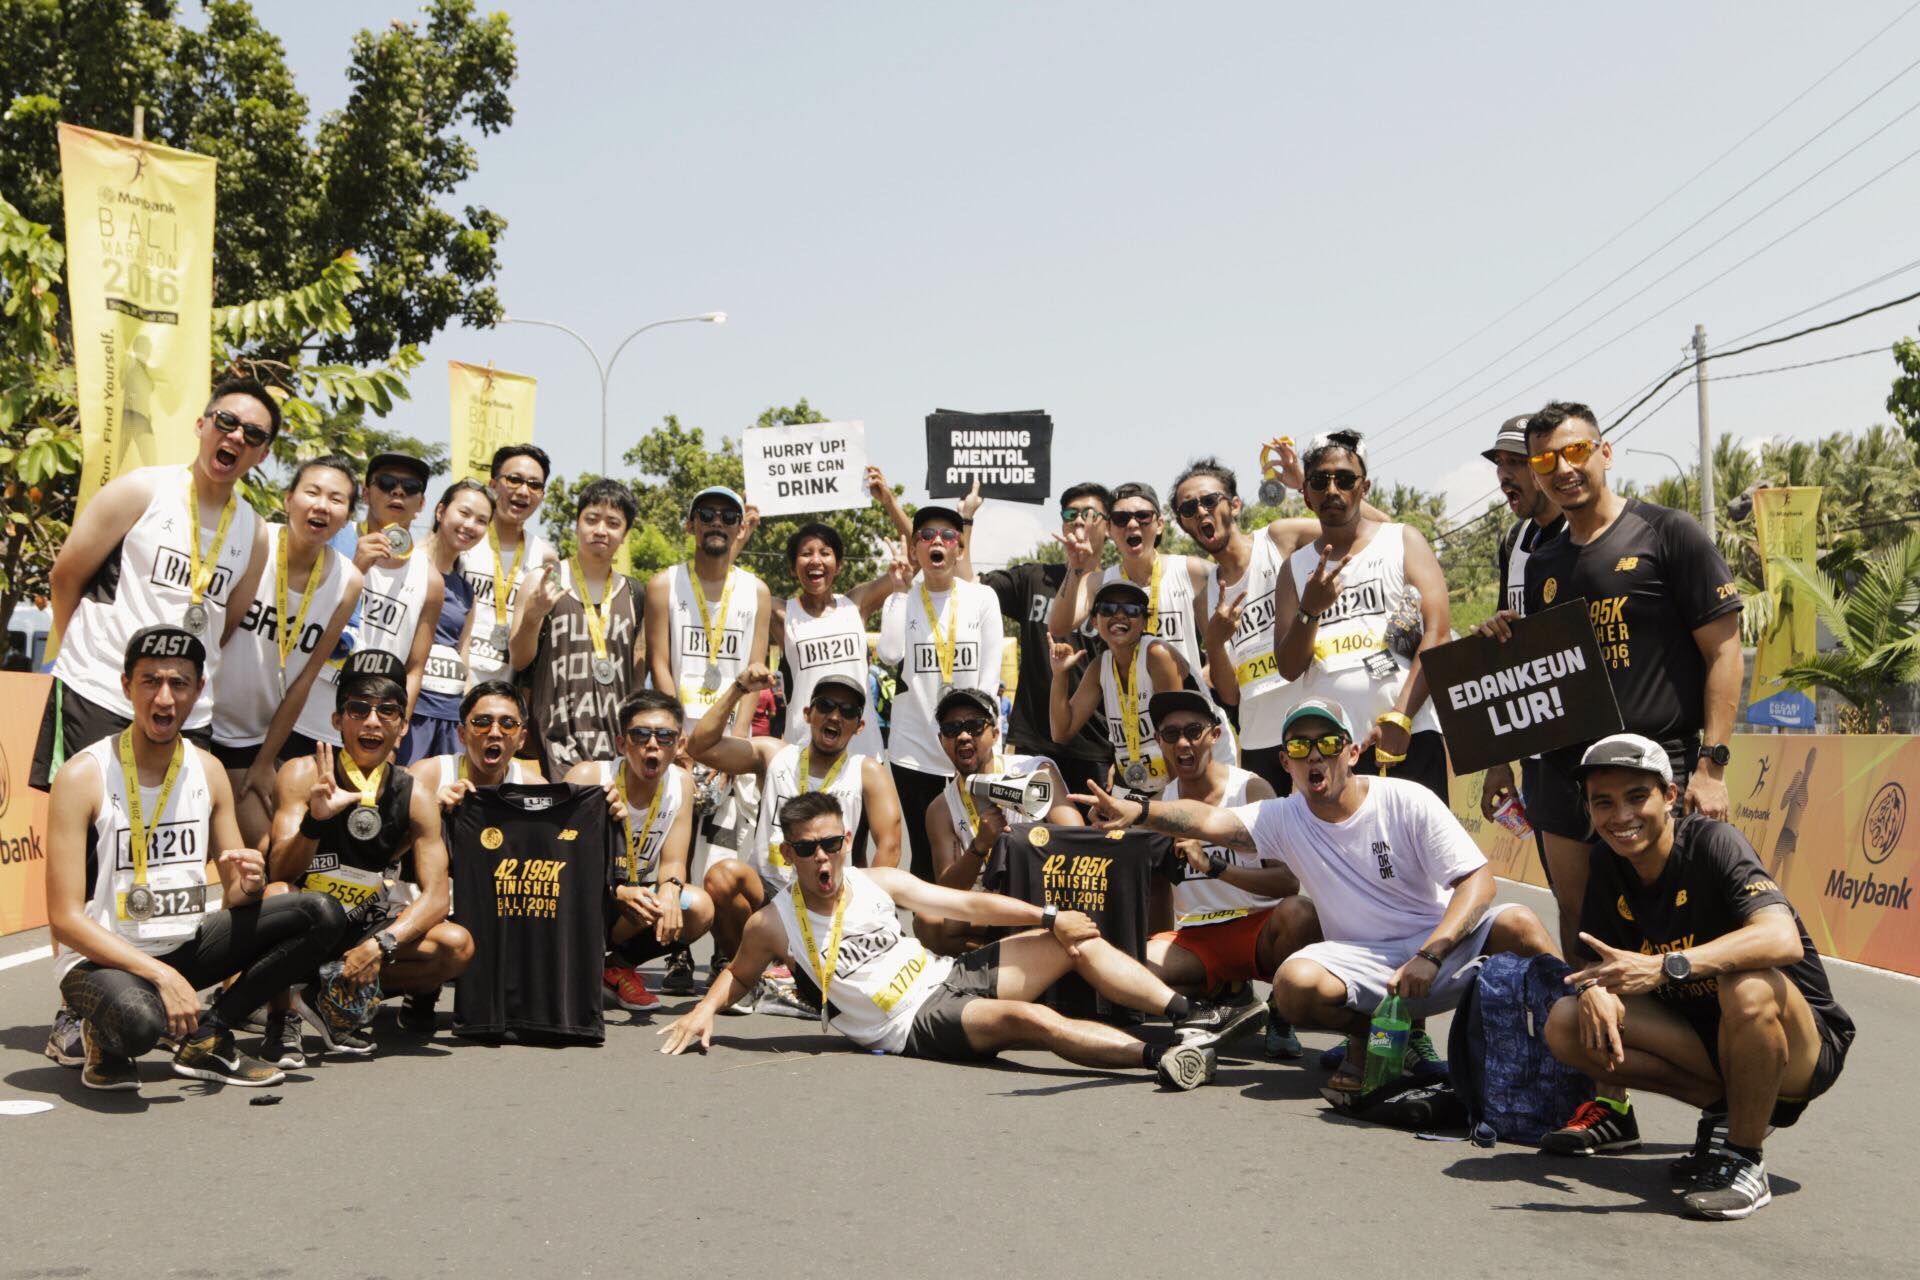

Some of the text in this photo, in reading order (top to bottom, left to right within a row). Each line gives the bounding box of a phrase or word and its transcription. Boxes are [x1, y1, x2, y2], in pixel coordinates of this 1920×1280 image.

[98, 207, 177, 250] BALI
[102, 258, 179, 306] 2016
[101, 329, 115, 401] Yourself.
[103, 407, 113, 443] Find
[763, 439, 846, 459] HURRY UP!
[951, 430, 1031, 447] RUNNING
[768, 459, 844, 476] SO WE CAN
[953, 449, 1028, 466] MENTAL
[946, 467, 1035, 484] ATTITUDE
[777, 477, 839, 497] DRINK
[141, 634, 192, 656] FAST
[805, 638, 855, 663] BR20
[1332, 634, 1374, 655] 1406
[353, 653, 395, 674] VOLT
[1448, 646, 1586, 710] EDANKEUN
[1487, 686, 1565, 736] LUR!
[1742, 804, 1771, 821] Maybank
[1378, 853, 1391, 867] OR
[496, 880, 560, 897] FINISHER
[1043, 875, 1108, 891] FINISHER
[1824, 869, 1913, 909] Maybank
[328, 882, 366, 906] 2556
[498, 897, 557, 911] BALI 2016
[1045, 890, 1105, 904] BALI 2016
[889, 958, 921, 994] 1770
